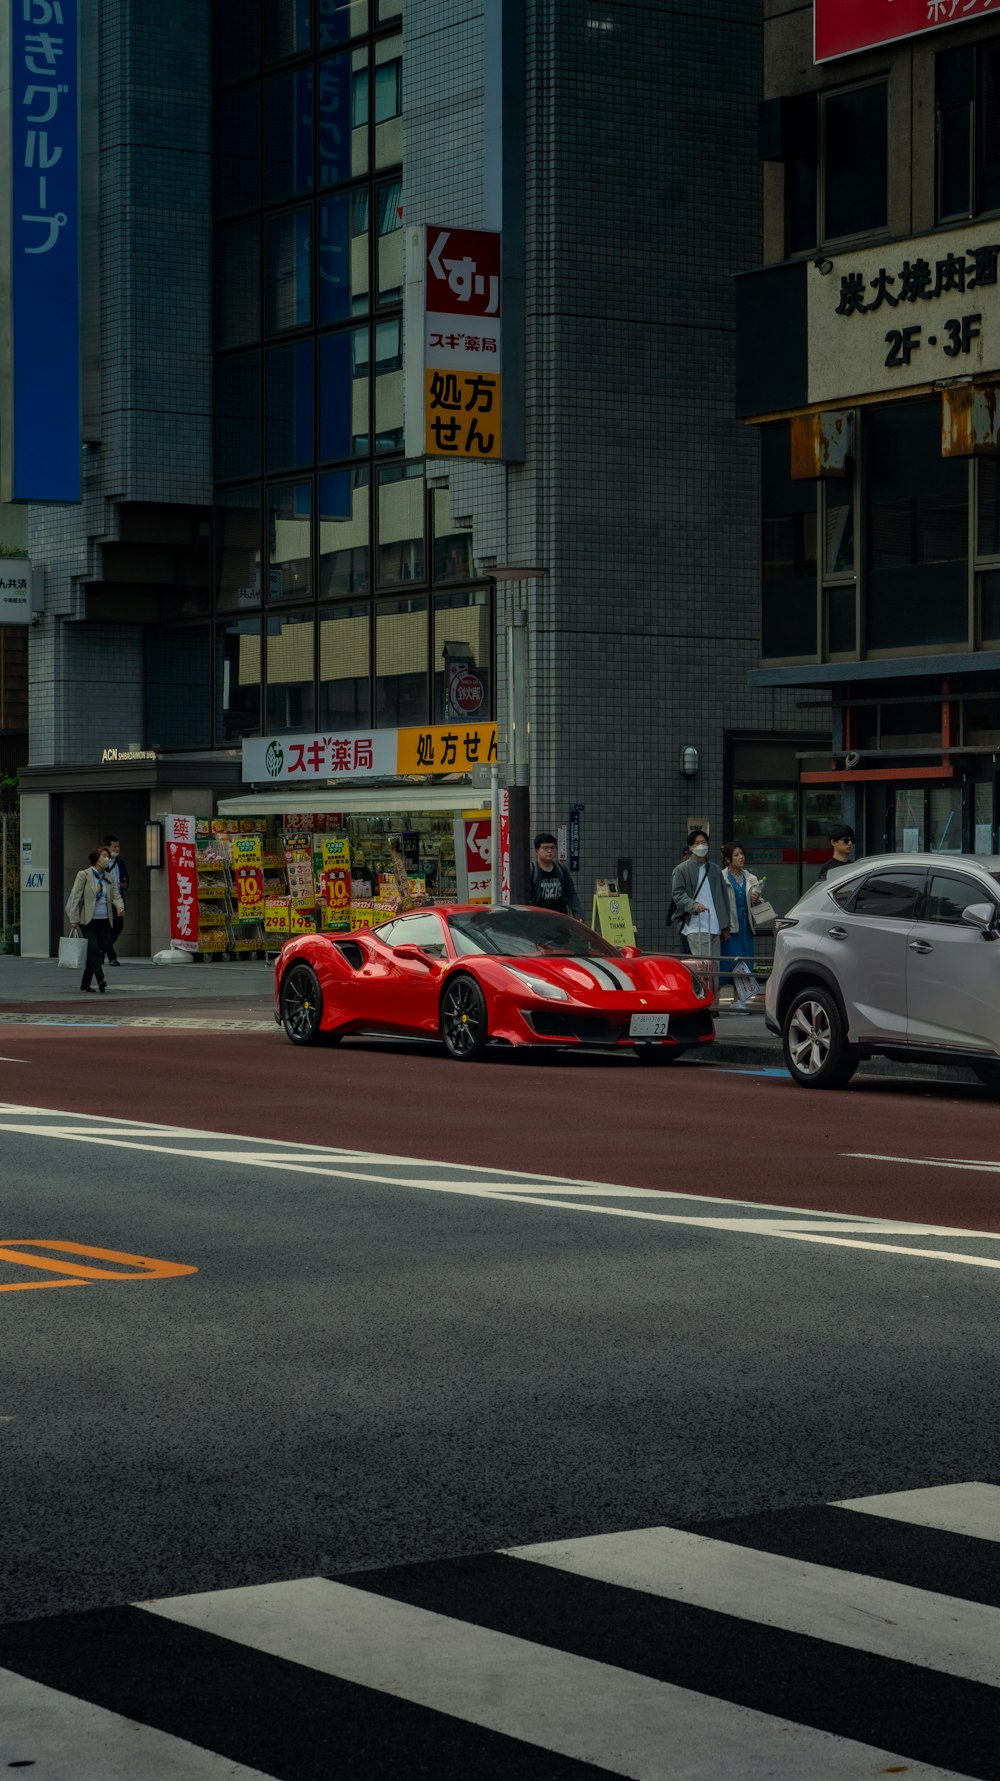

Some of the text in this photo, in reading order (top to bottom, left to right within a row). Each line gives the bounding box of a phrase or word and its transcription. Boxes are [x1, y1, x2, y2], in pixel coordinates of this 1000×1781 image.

[428, 232, 499, 314] くすり
[430, 333, 497, 353] スギ薬局
[430, 372, 496, 412] 処方
[431, 416, 494, 453] せん
[102, 749, 118, 762] ACN
[288, 736, 373, 773] スギ薬局
[26, 873, 44, 887] ACN
[241, 895, 260, 903] OFF
[330, 898, 347, 906] OFF
[267, 917, 286, 927] 298
[653, 1023, 666, 1034] 22
